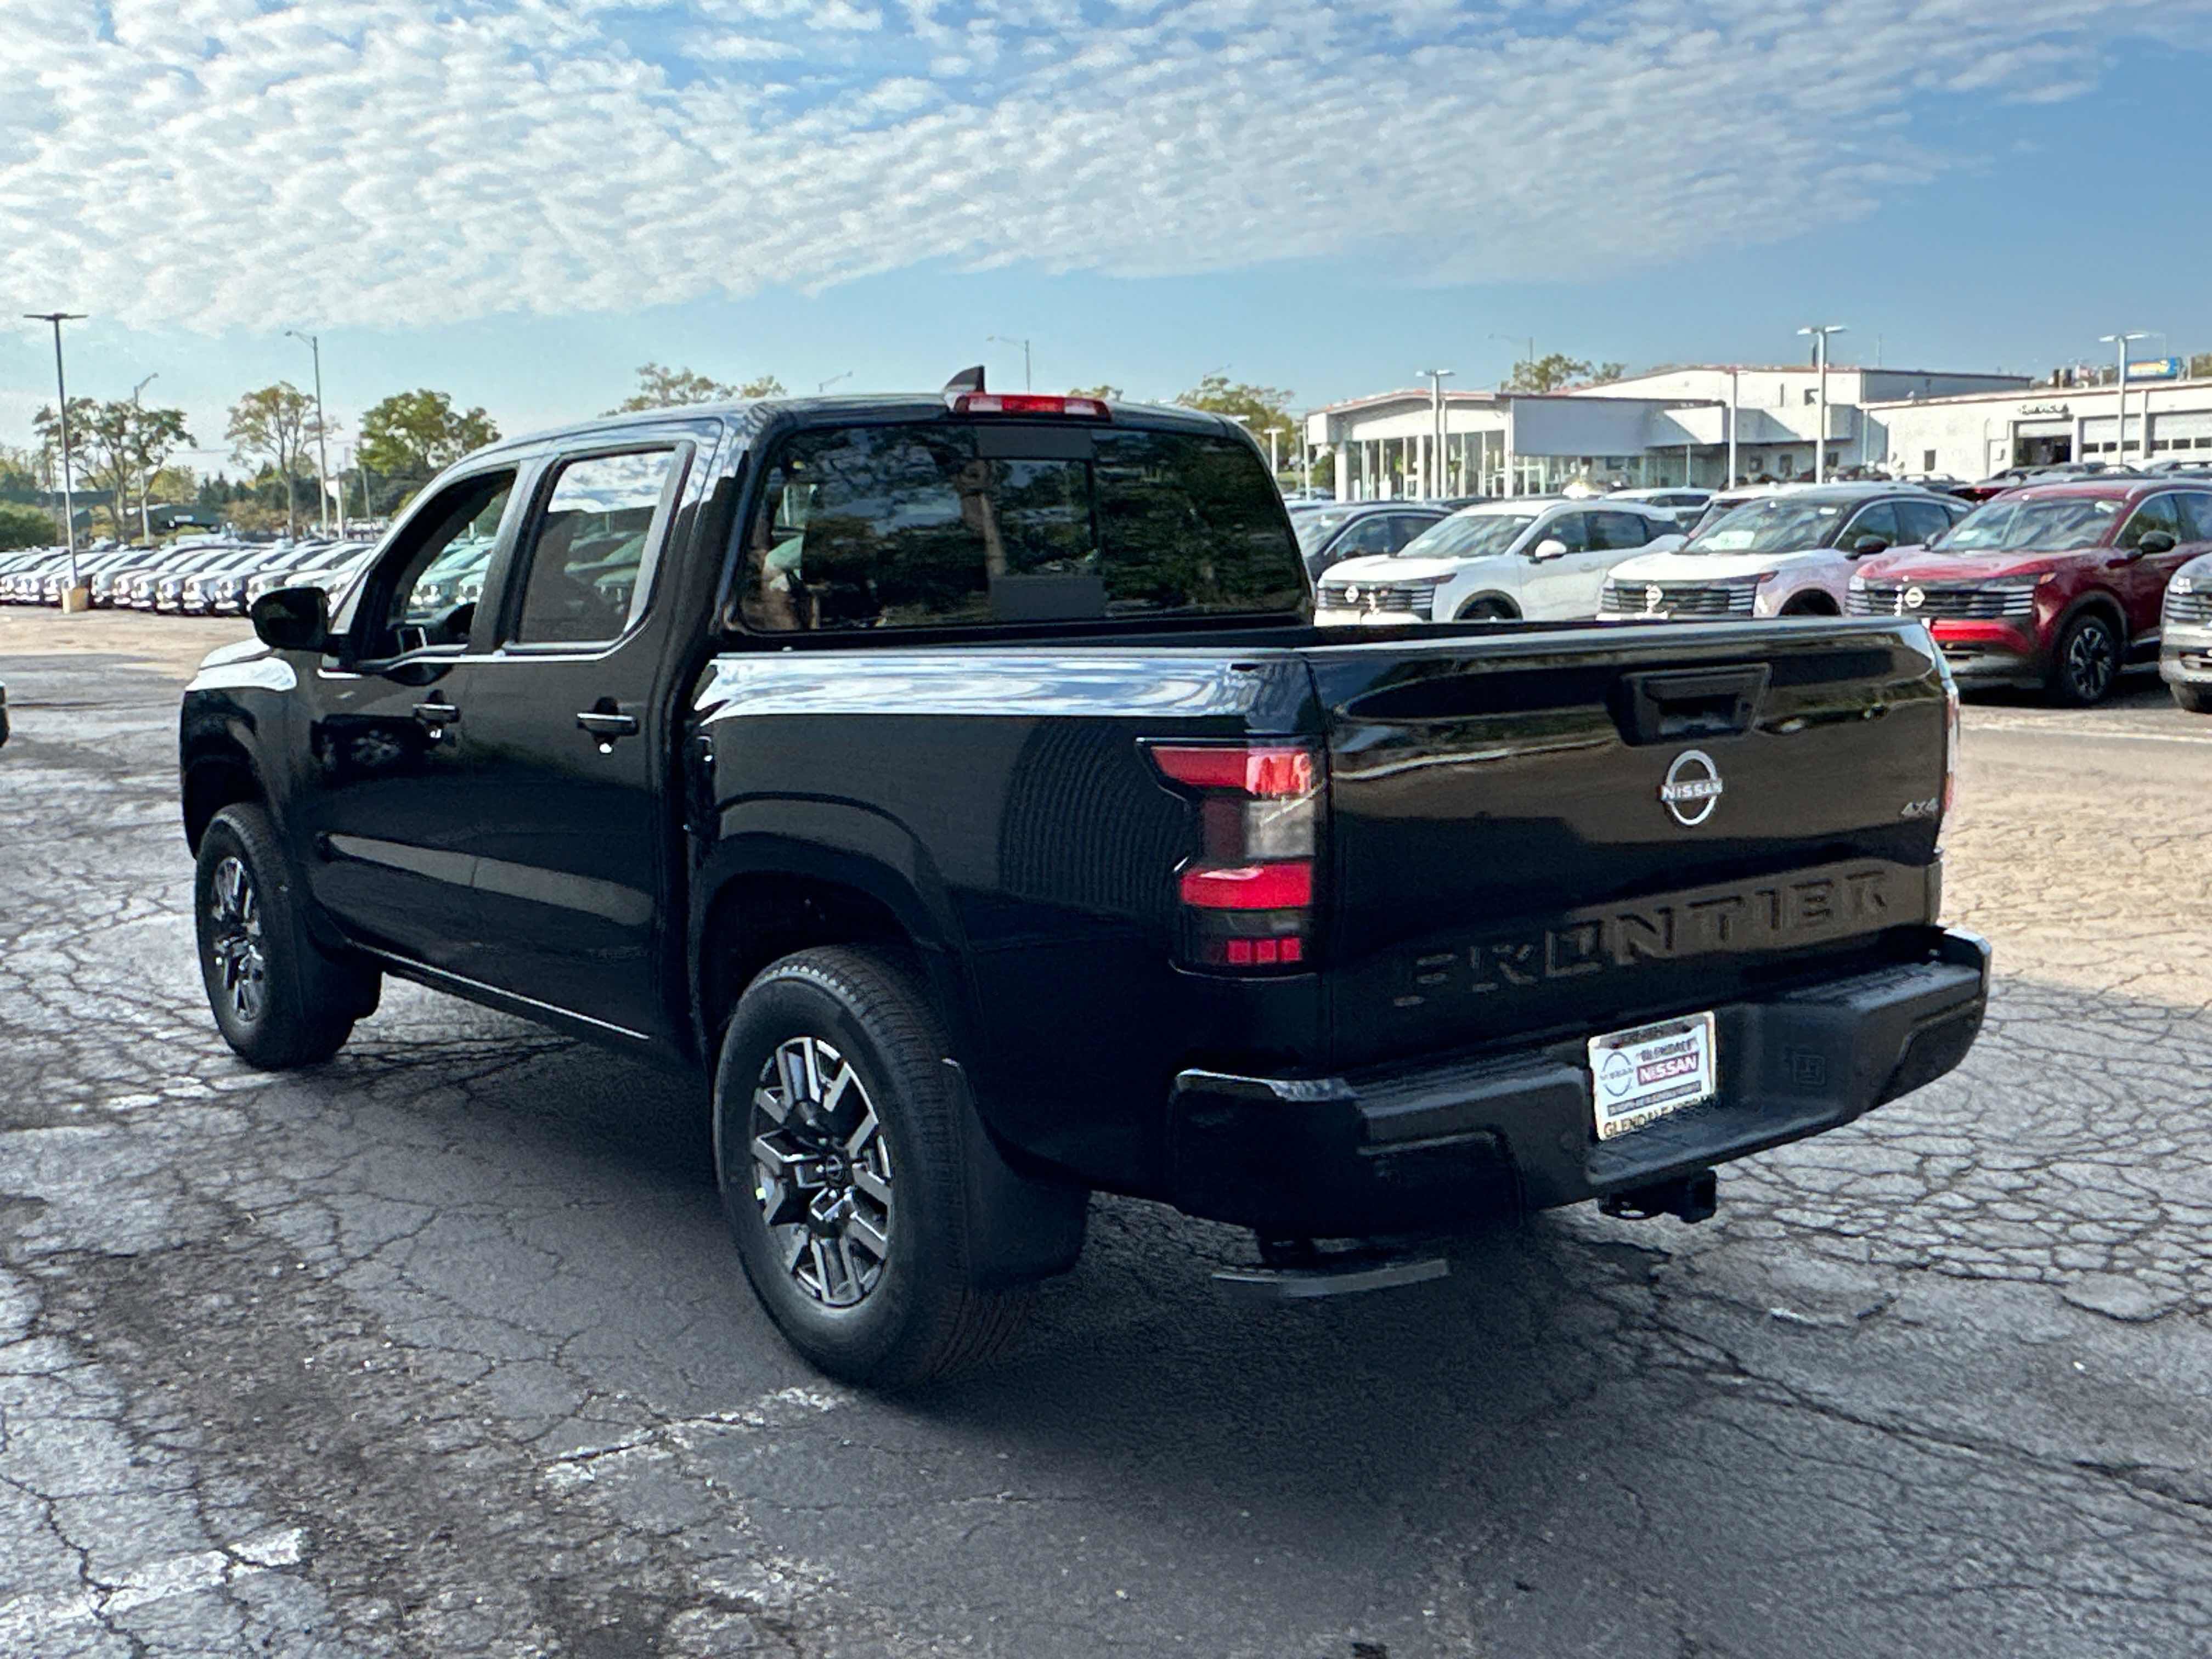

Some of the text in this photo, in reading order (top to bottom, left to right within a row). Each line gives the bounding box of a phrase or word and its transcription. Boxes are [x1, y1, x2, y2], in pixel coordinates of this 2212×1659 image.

[1661, 778, 1723, 801] NISSAN
[1392, 869, 1891, 1008] FRONTIER
[1639, 1054, 1697, 1084] NISSAN
